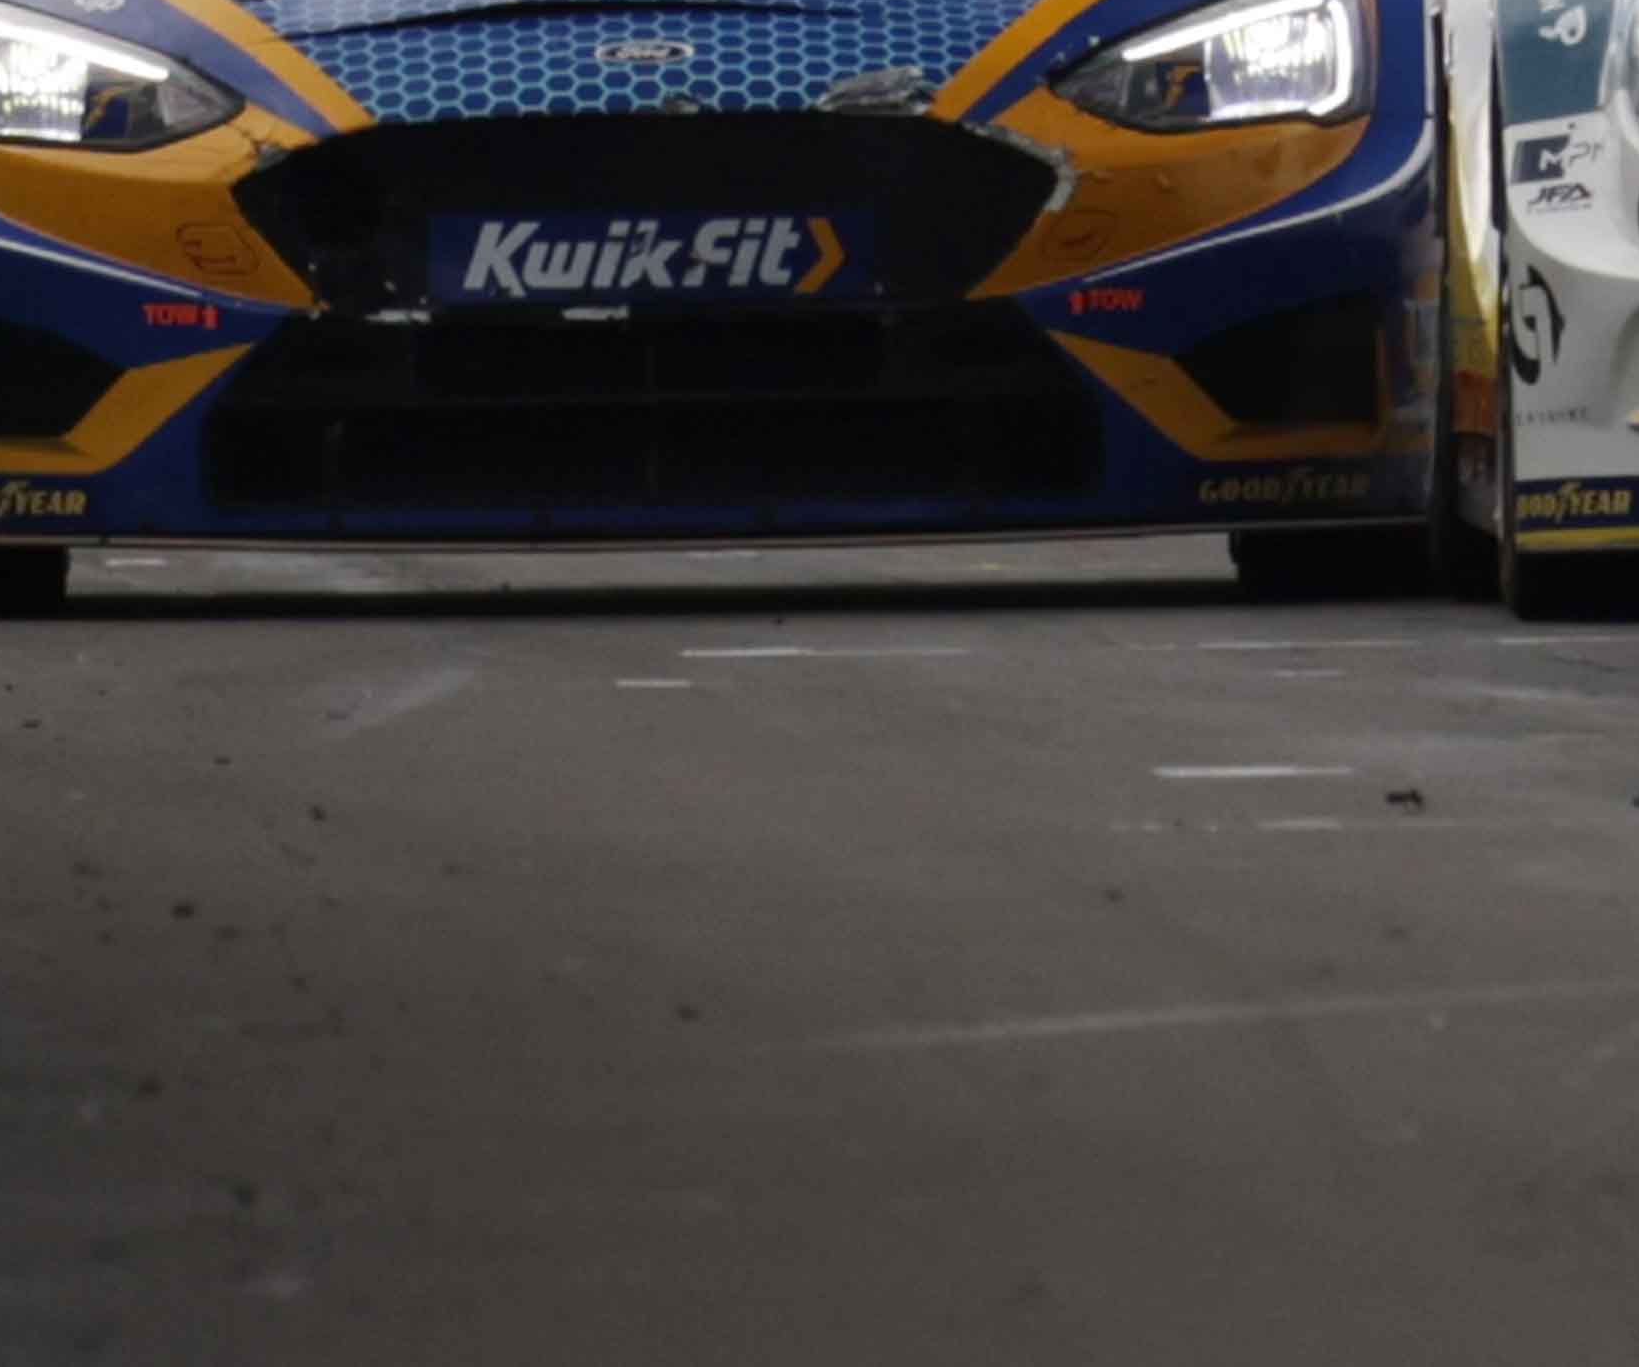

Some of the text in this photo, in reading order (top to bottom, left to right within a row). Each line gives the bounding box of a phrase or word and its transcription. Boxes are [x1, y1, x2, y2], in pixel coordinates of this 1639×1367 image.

[463, 218, 801, 298] KwikFit
[1089, 288, 1143, 312] TOW
[143, 303, 198, 326] TOW
